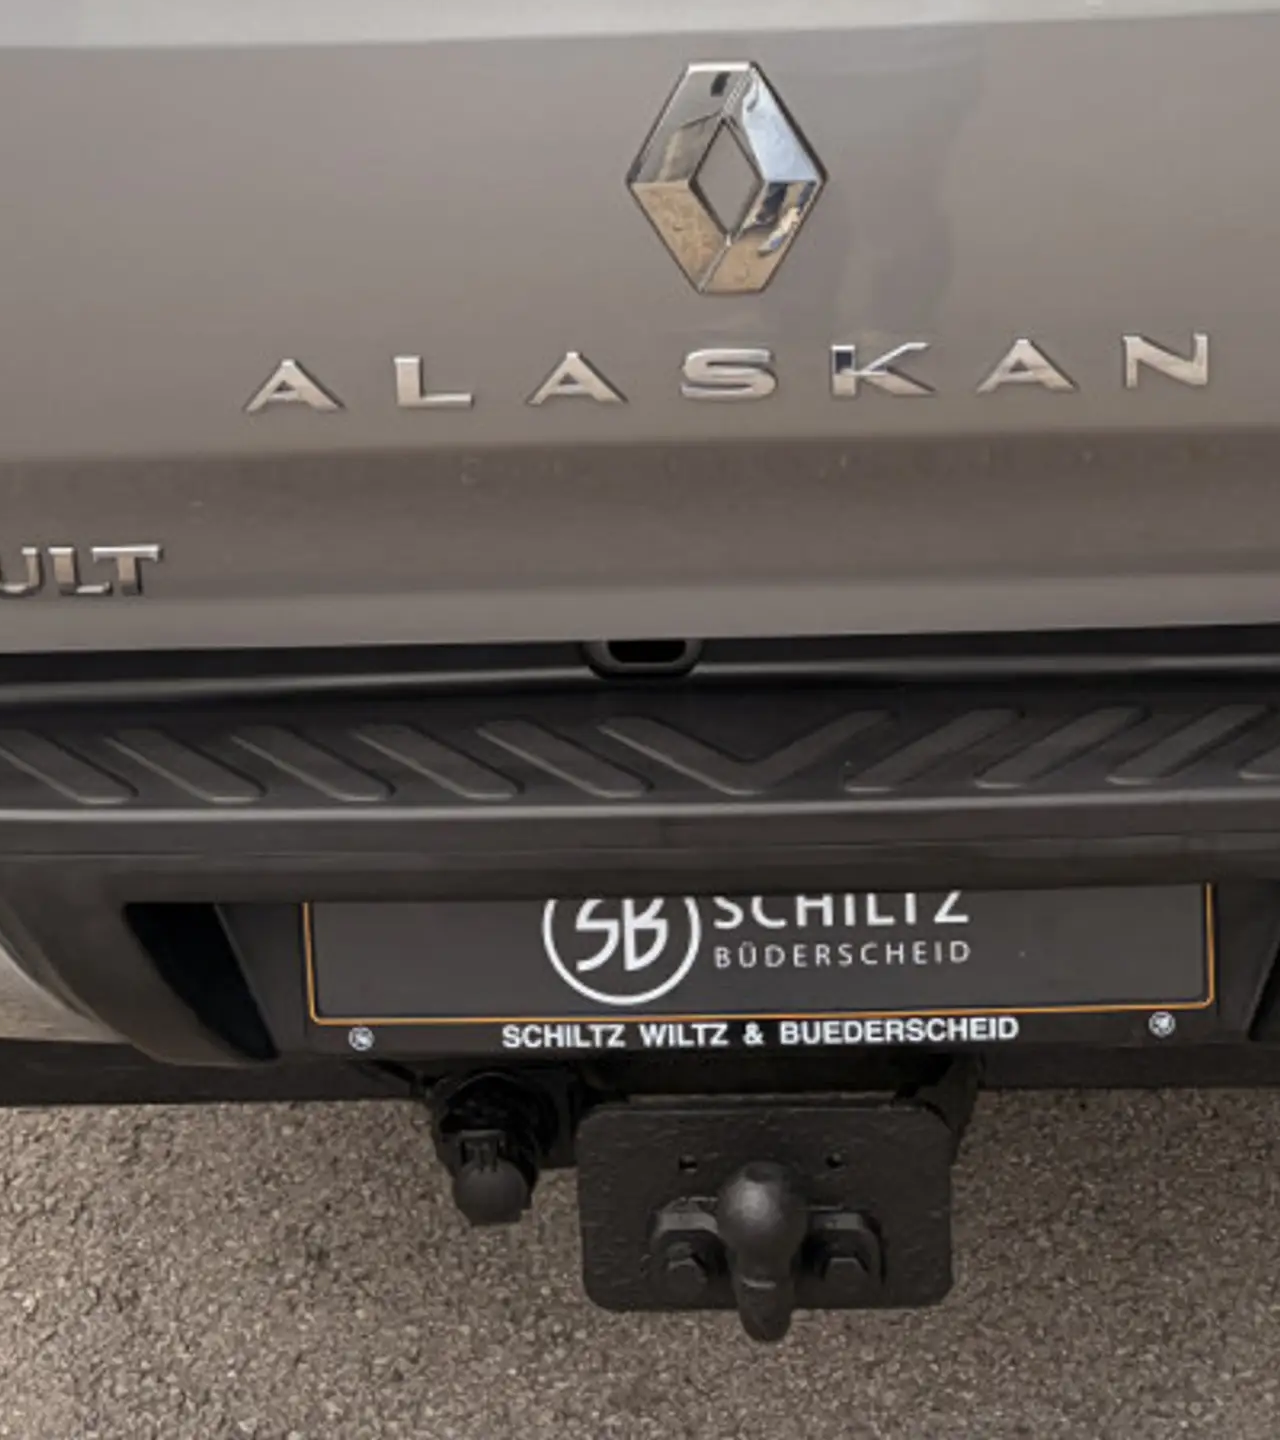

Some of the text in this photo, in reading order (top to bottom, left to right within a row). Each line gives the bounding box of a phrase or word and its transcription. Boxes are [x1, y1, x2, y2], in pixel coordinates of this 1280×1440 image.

[243, 331, 1211, 413] ALASKAN
[713, 940, 971, 969] BÜDERSCHEID
[502, 1016, 1020, 1048] SCHILTZ WILTZ & BUEDERSCHEID
